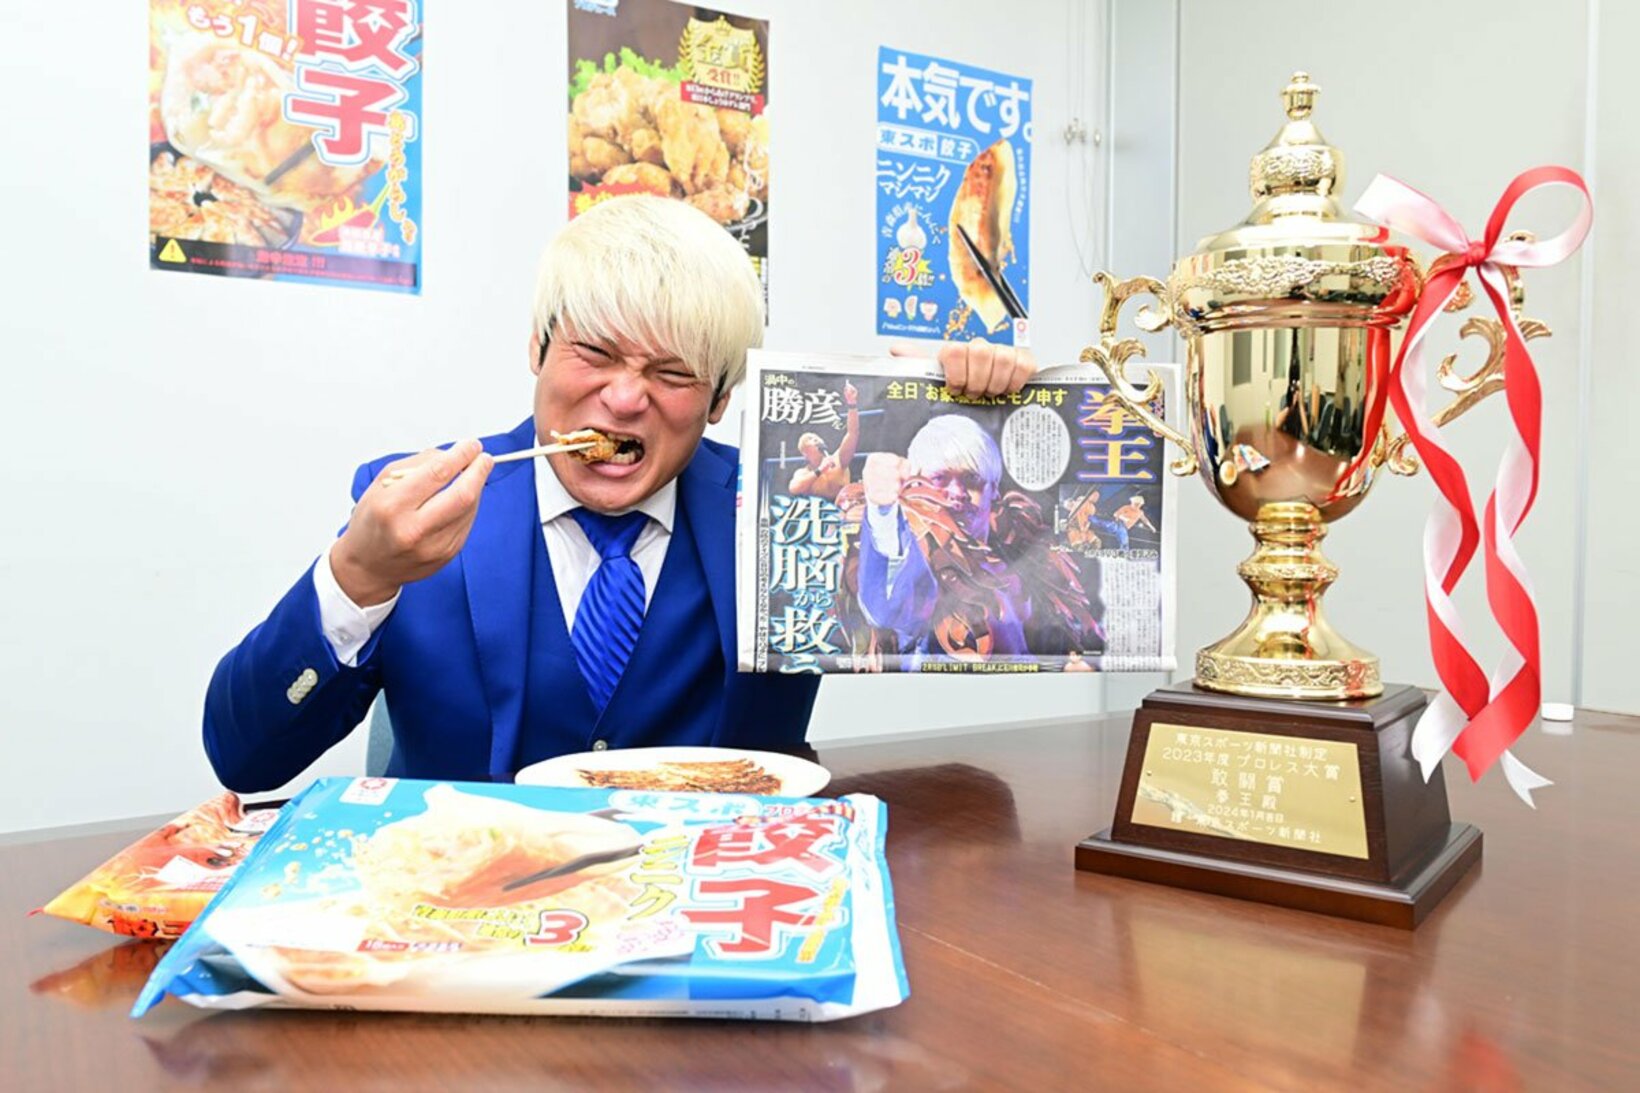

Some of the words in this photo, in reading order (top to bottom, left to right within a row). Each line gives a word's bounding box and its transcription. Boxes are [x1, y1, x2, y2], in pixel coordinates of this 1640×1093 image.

[187, 4, 298, 60] もう1!
[880, 55, 1032, 143] 本気です。
[879, 128, 936, 152] 東スポ
[940, 137, 973, 160] 餃子
[876, 160, 951, 187] ニンニク
[879, 179, 942, 203] マシマシ
[1161, 746, 1230, 767] 2023年度
[1237, 753, 1341, 781] プロレス大賞
[1174, 732, 1329, 762] 東京スポーツ新聞社制定
[1196, 813, 1322, 844] スポーツ新聞社
[680, 814, 836, 954] 餃子
[524, 909, 590, 946] 3
